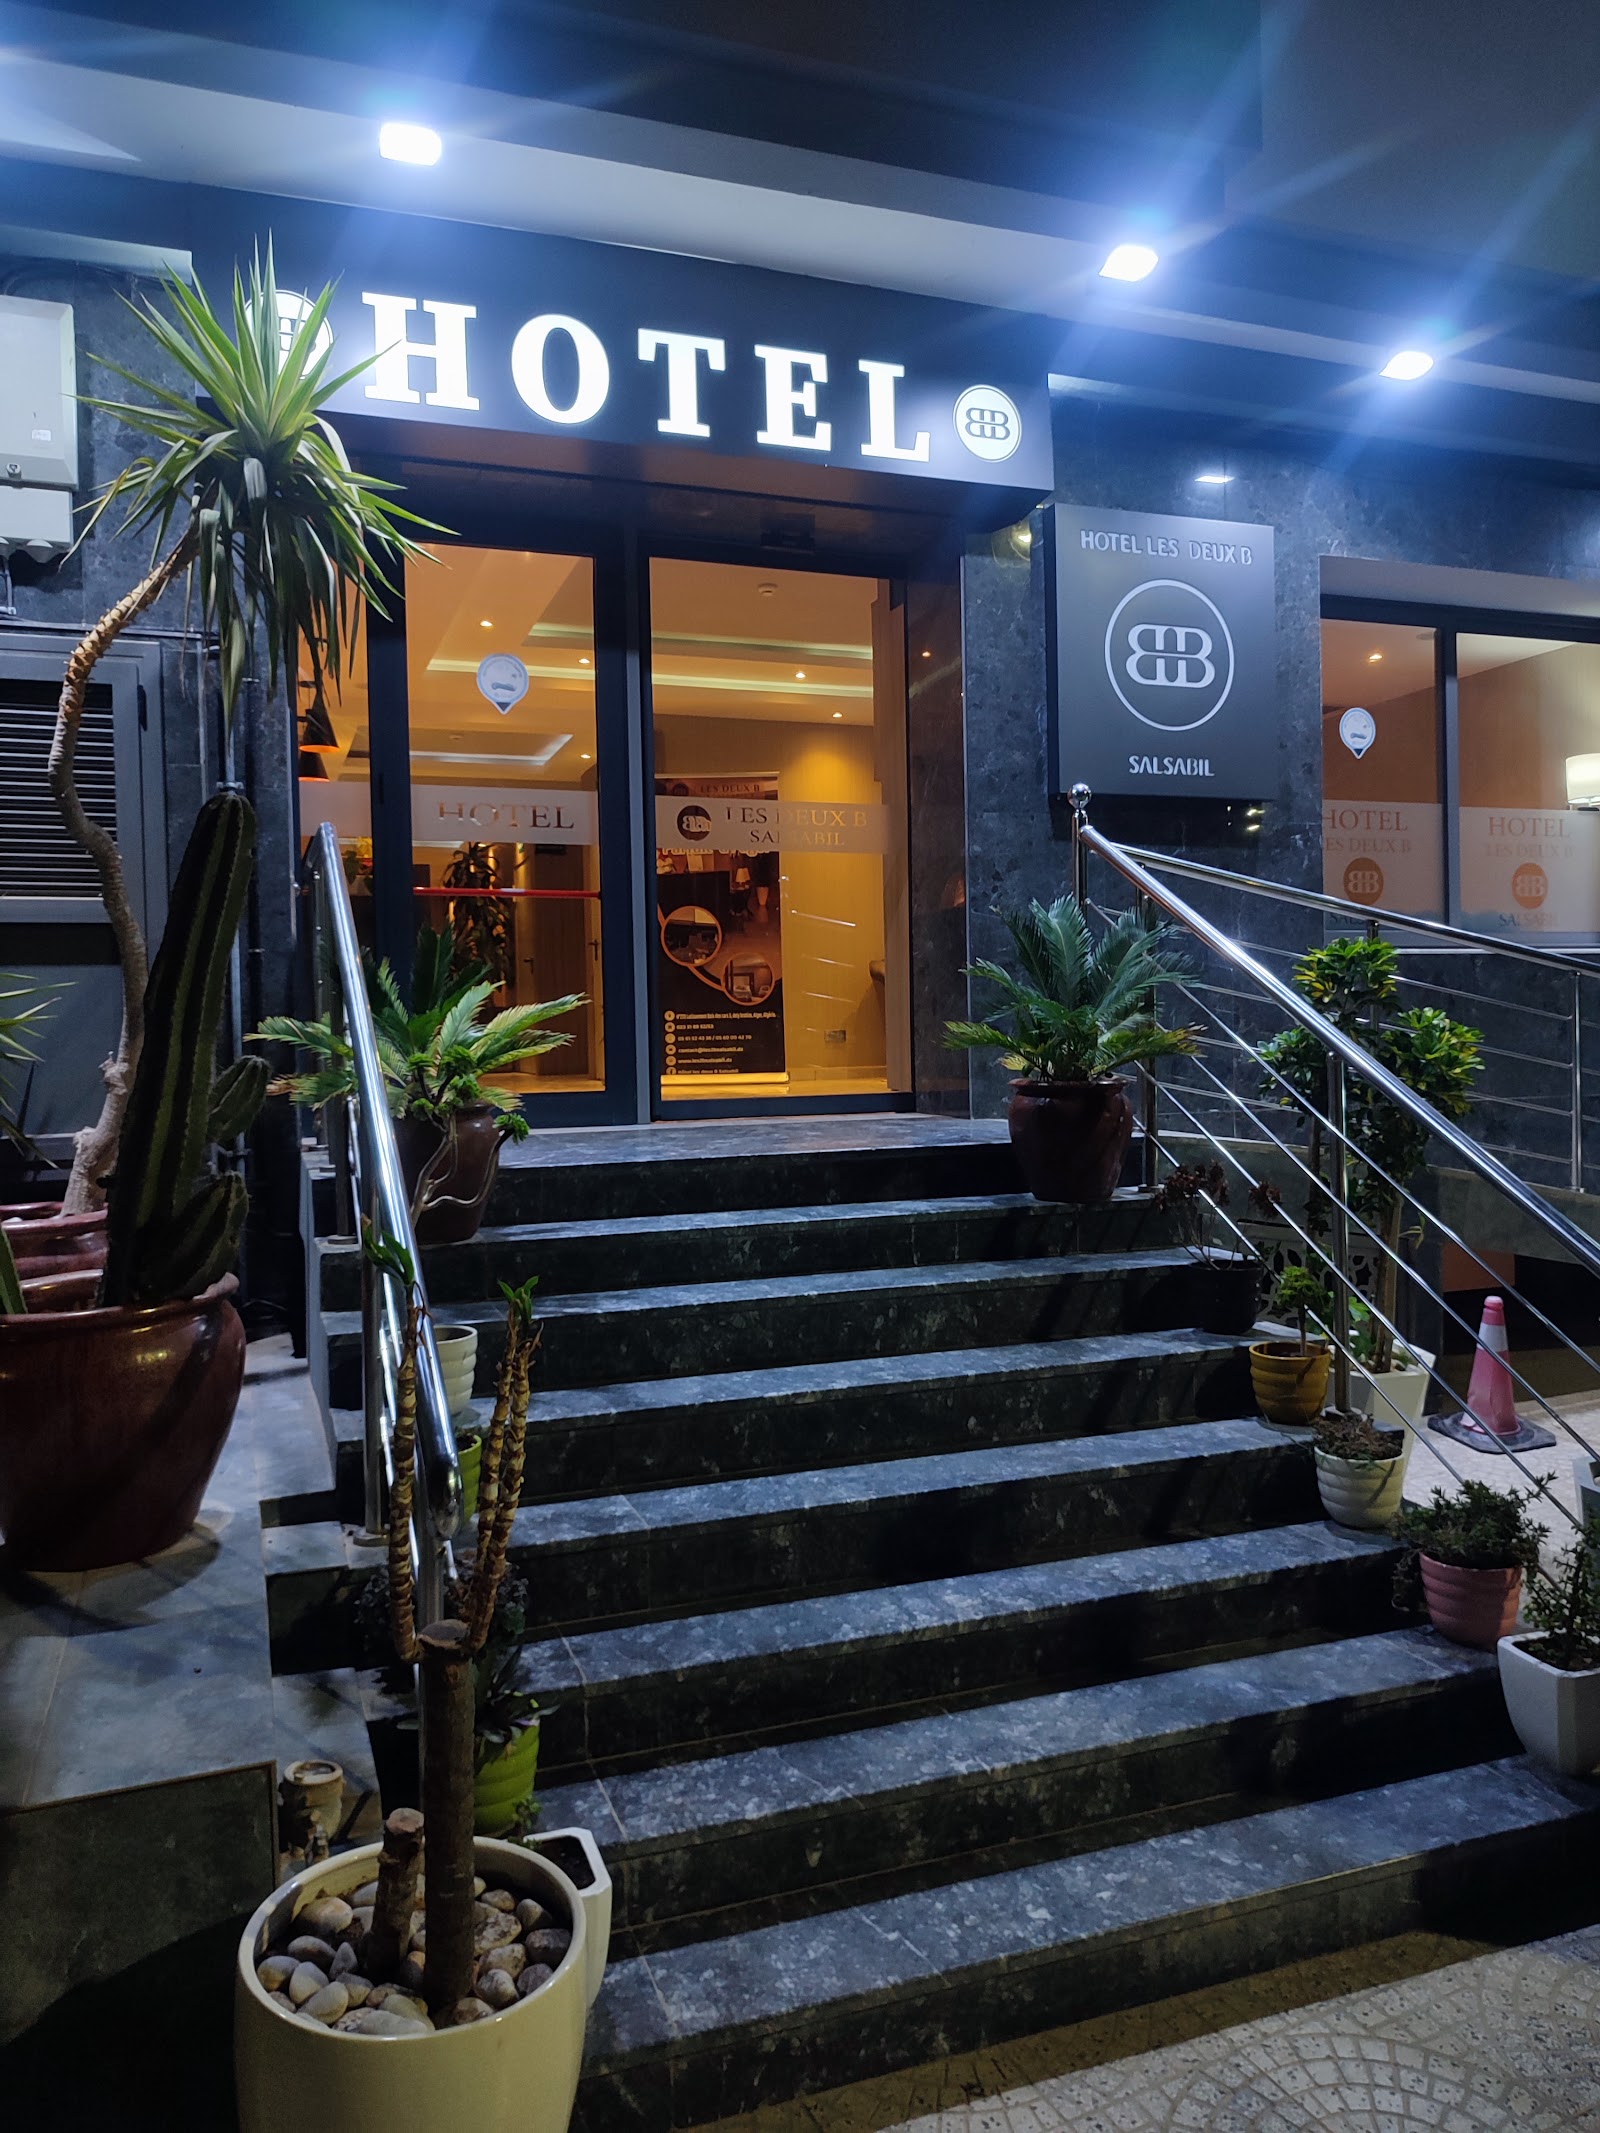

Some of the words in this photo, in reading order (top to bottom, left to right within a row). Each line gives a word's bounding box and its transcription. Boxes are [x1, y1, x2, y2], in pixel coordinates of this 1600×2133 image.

[361, 291, 930, 462] HOTEL
[1080, 530, 1142, 554] HOTEL
[1147, 536, 1179, 558] LES
[1189, 541, 1236, 564] DEUX
[1241, 547, 1253, 565] B
[1129, 755, 1215, 777] SALSABIL
[437, 800, 576, 830] HOTEL
[854, 811, 867, 827] B
[1323, 808, 1408, 832] HOTEL
[750, 829, 845, 847] SALABIL
[1488, 816, 1570, 838] HOTEL
